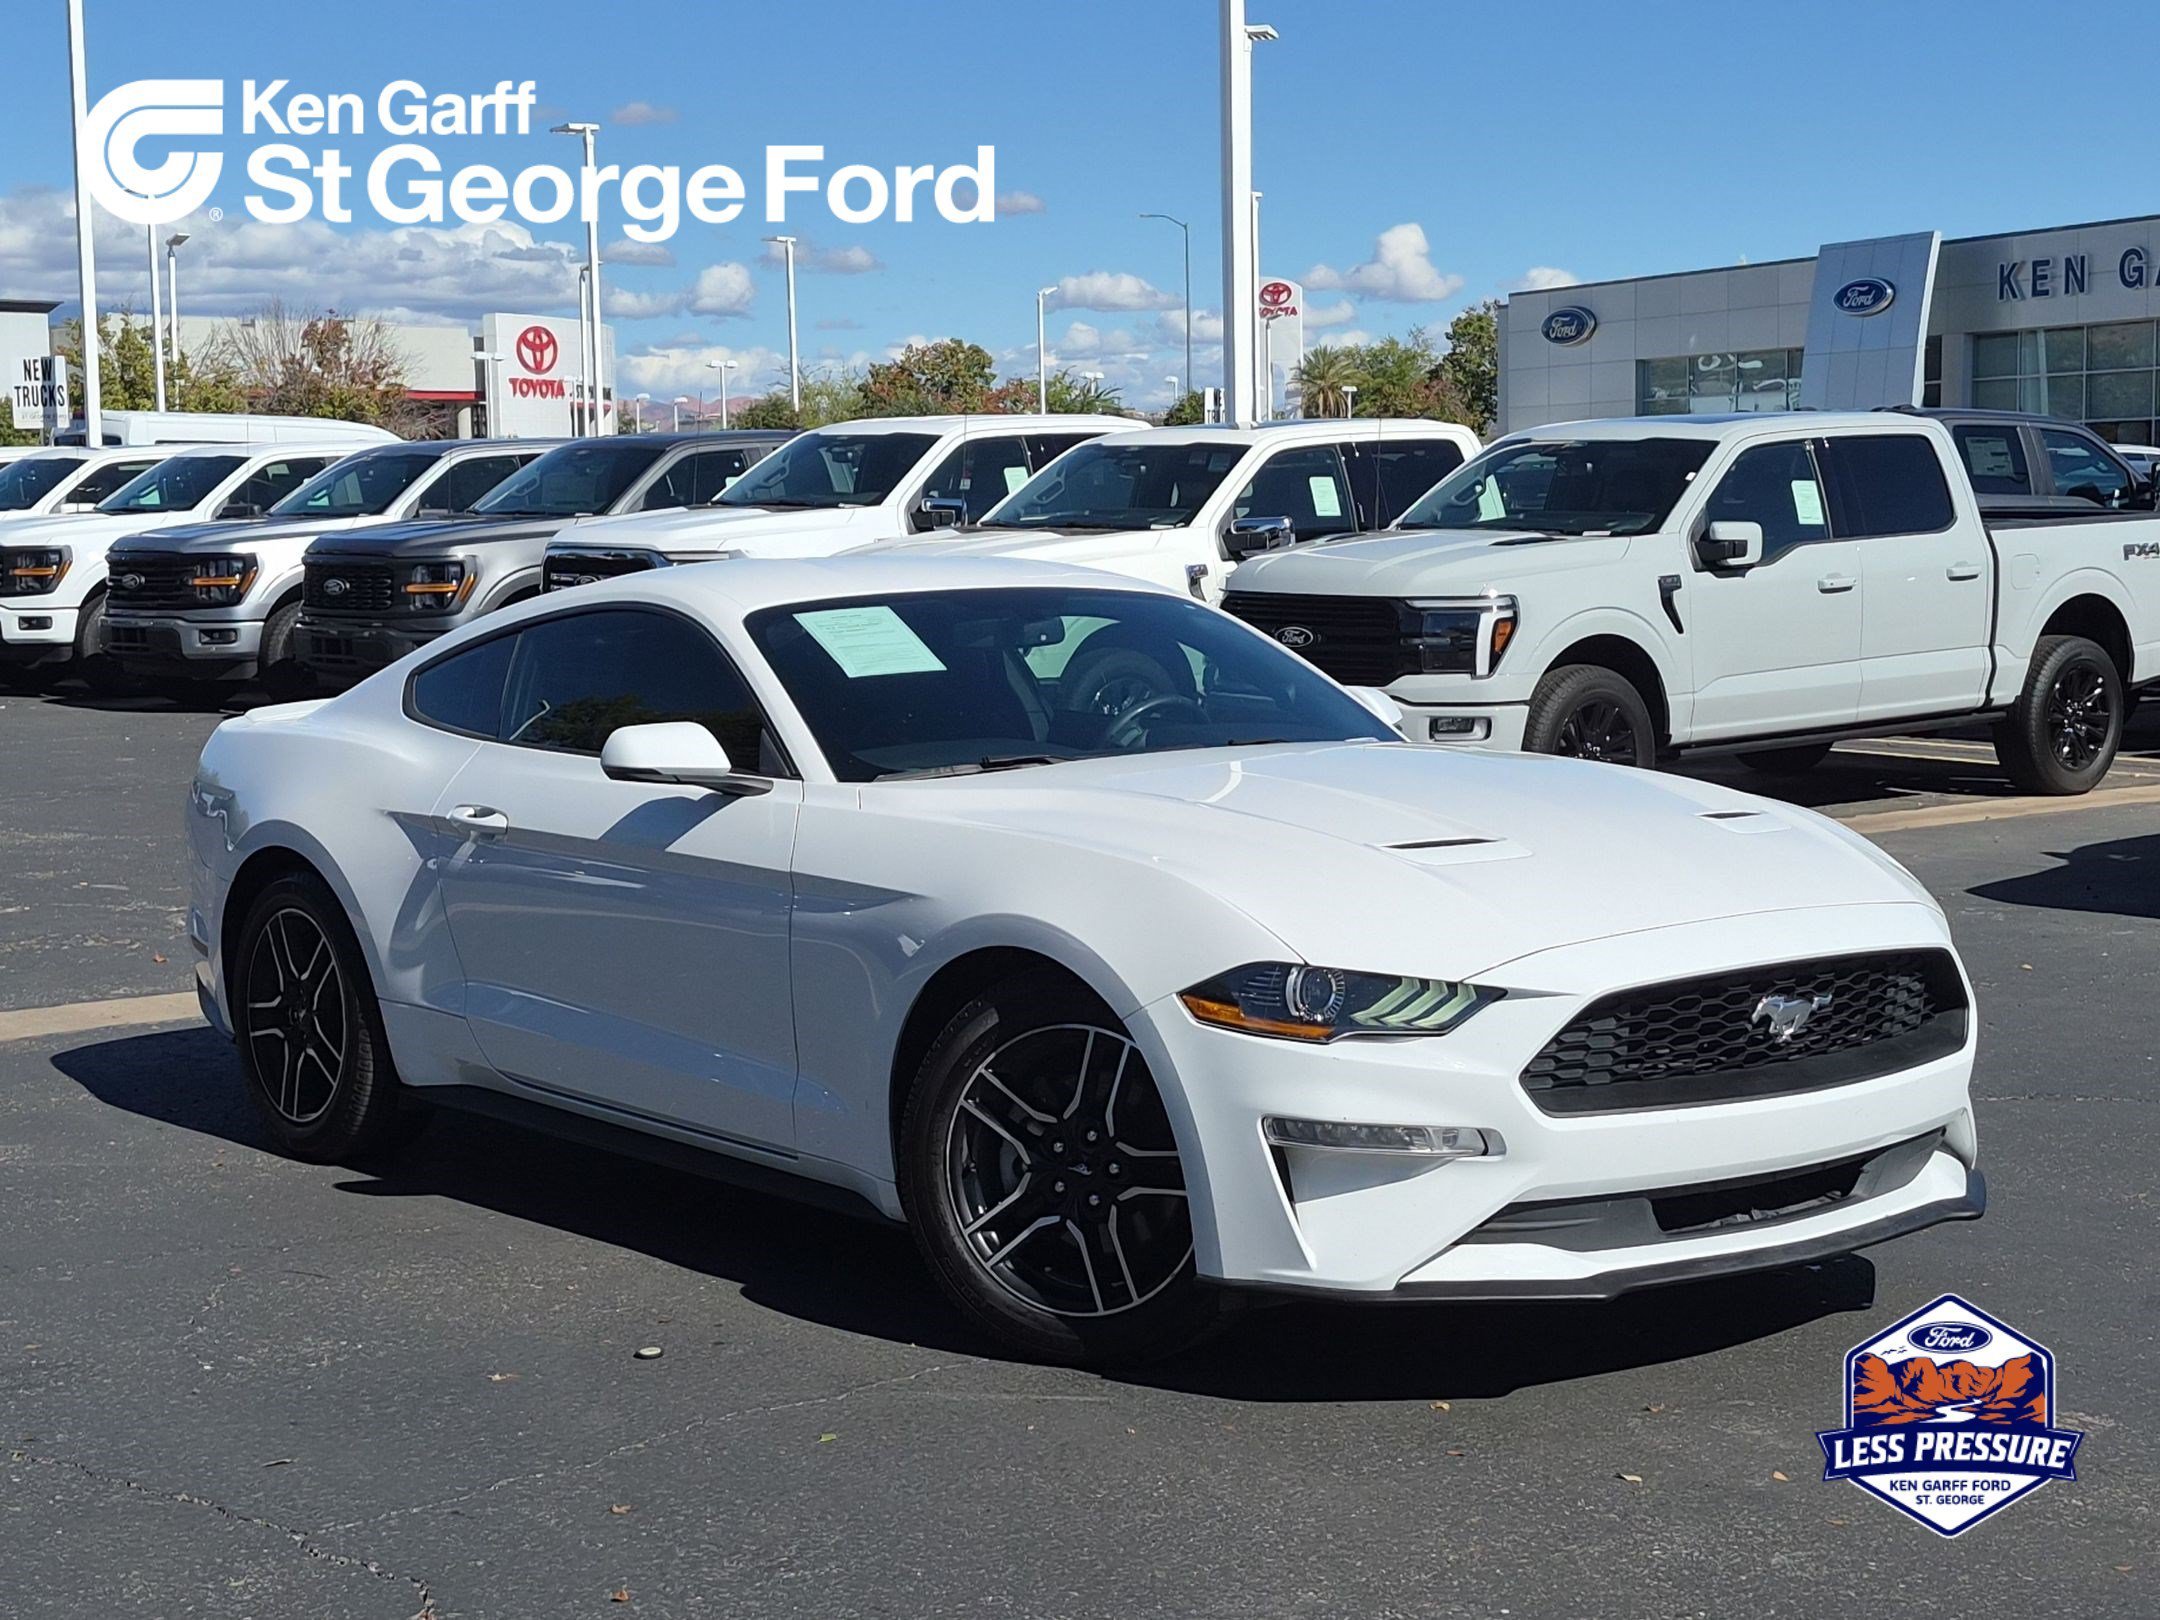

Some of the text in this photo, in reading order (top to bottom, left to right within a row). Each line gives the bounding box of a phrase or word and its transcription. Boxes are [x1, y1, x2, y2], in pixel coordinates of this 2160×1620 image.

[1998, 254, 2087, 301] KEN
[1841, 285, 1876, 308] Ford
[1549, 316, 1578, 339] Ford
[23, 358, 53, 382] NEW
[14, 384, 66, 408] TRUCKS
[508, 378, 566, 399] TOYOTA
[2123, 542, 2159, 561] FX4
